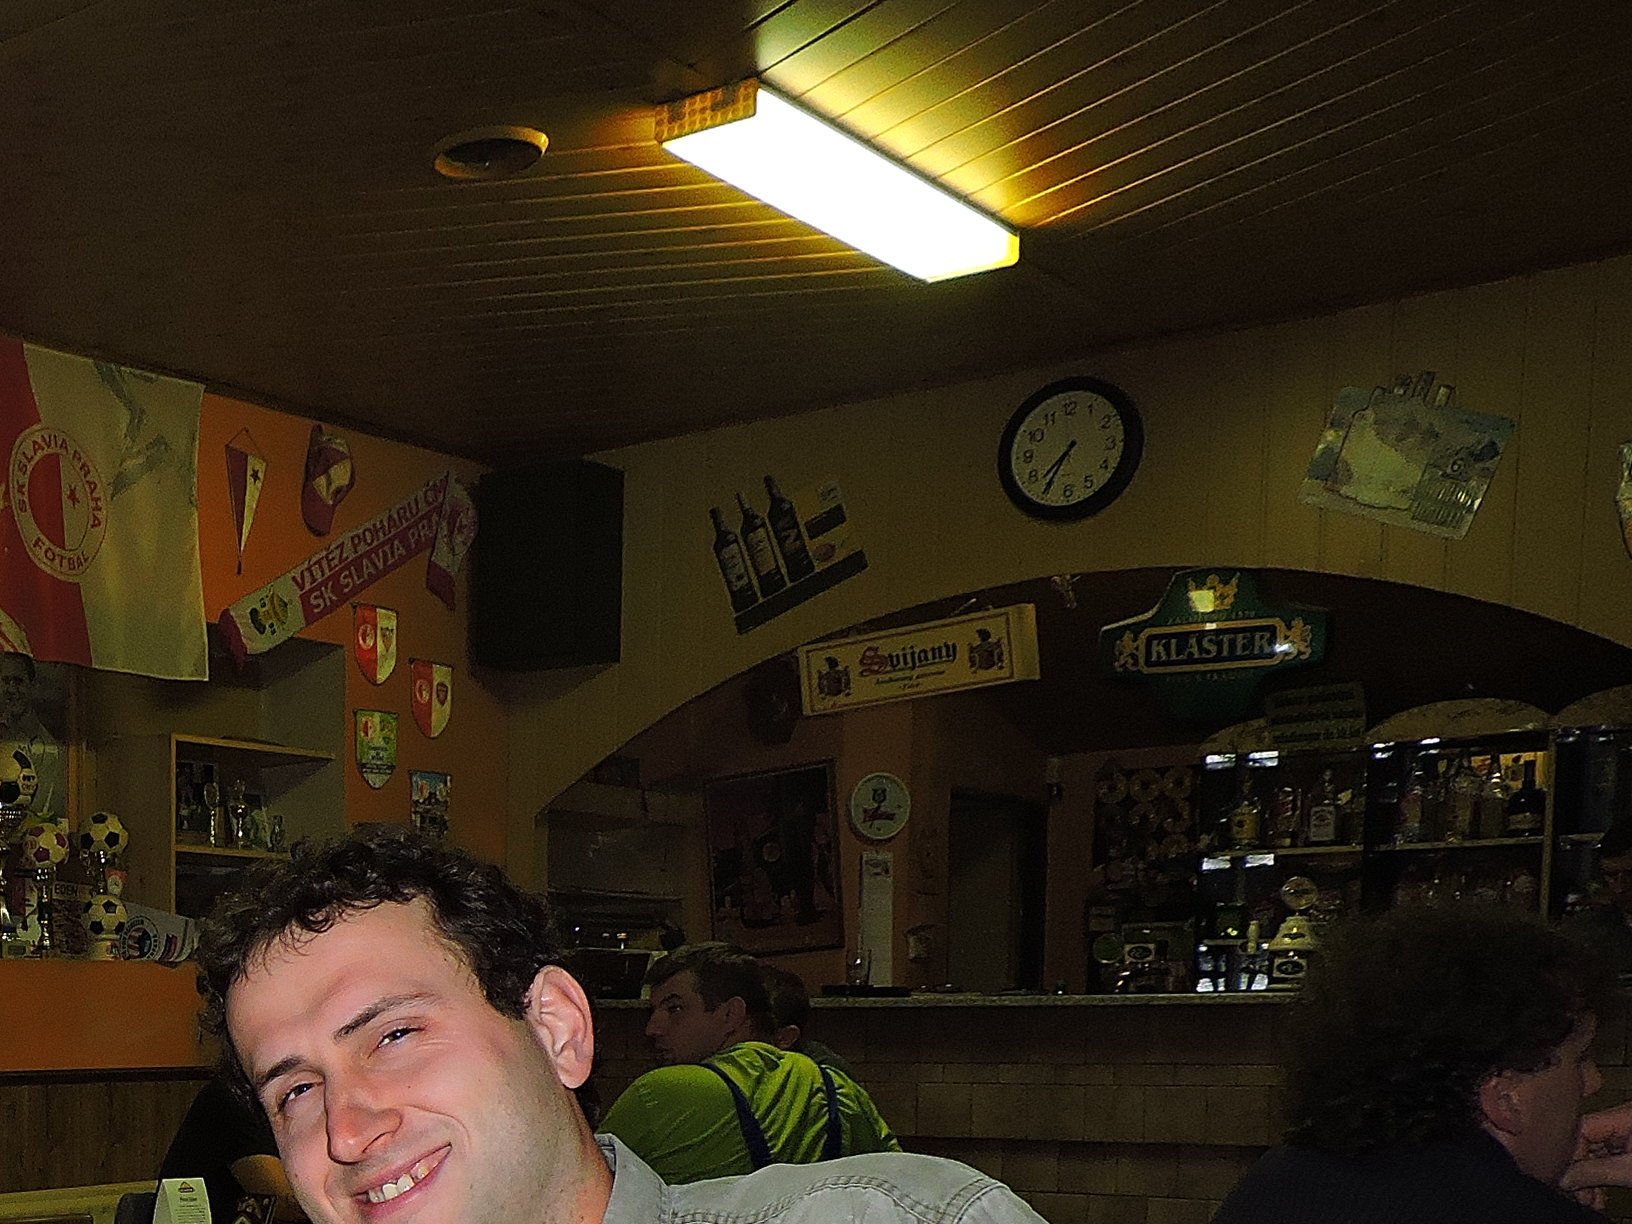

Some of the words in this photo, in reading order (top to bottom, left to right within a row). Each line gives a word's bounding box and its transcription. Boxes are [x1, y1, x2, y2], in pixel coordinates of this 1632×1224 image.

[1063, 401, 1077, 416] 12
[1044, 411, 1057, 426] 11
[1028, 428, 1045, 443] 10
[17, 434, 69, 476] SLAVIA
[1023, 450, 1034, 464] 9
[1028, 469, 1039, 484] 8
[1084, 474, 1094, 489] 5
[16, 478, 27, 513] SK
[72, 450, 103, 529] PRAHA
[1063, 484, 1073, 498] 6
[32, 536, 90, 571] FOTBAL
[309, 581, 338, 614] SK
[339, 540, 406, 594] SLAVIA
[859, 641, 957, 677] Svijany
